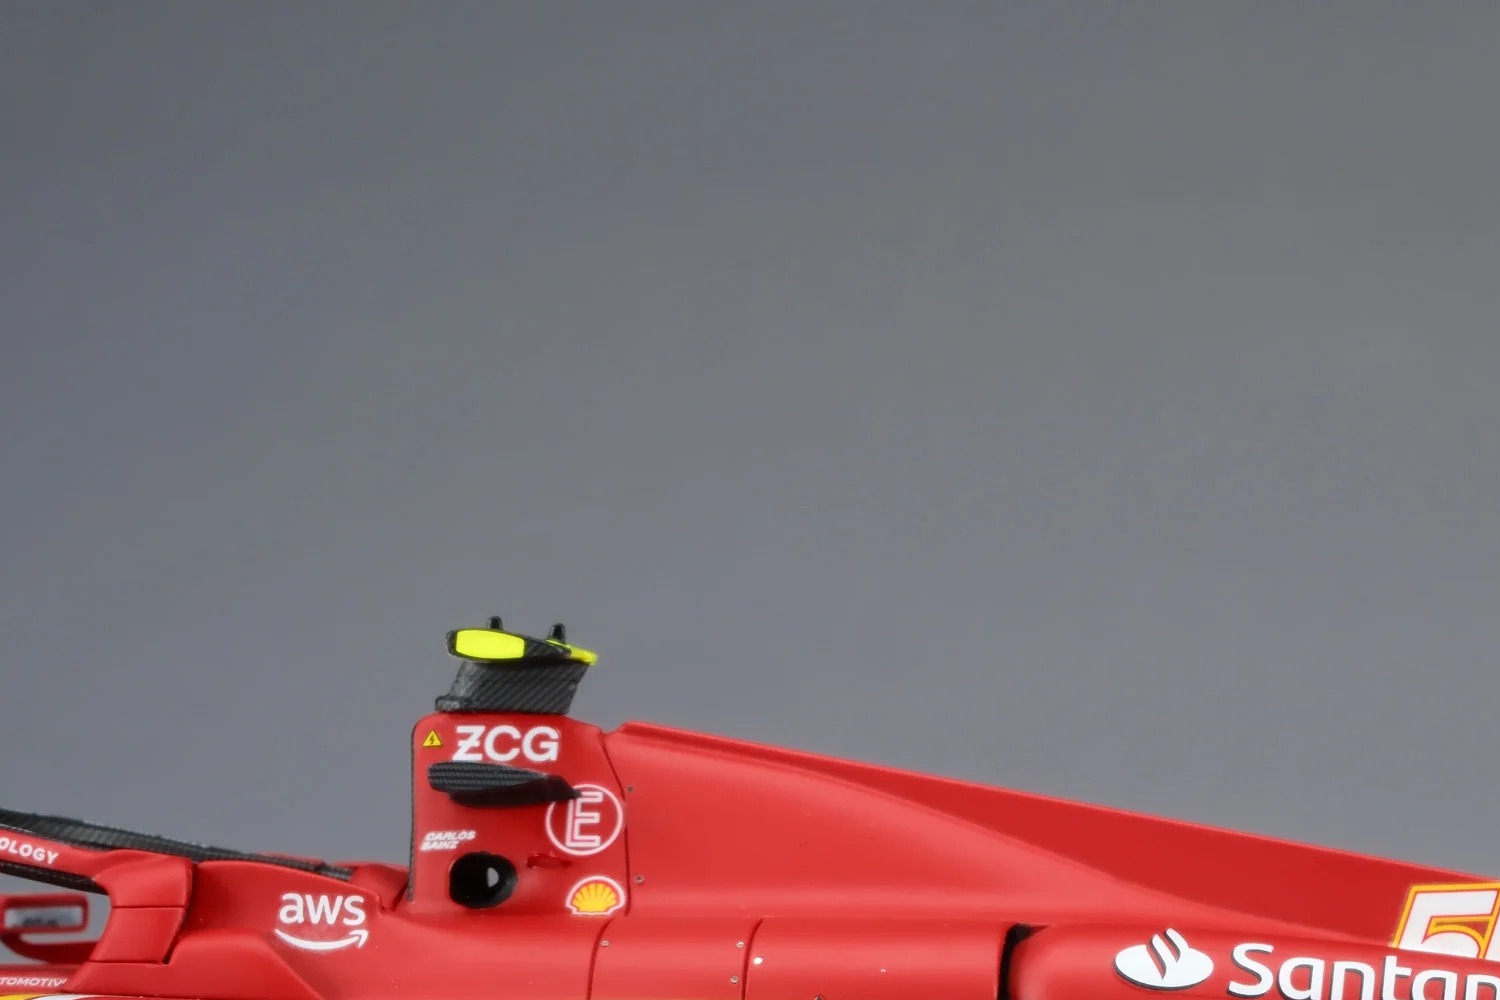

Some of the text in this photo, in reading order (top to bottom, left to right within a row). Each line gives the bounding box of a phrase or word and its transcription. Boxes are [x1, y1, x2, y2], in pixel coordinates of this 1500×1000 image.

[452, 725, 561, 762] ZCG
[279, 893, 366, 926] aws
[0, 977, 68, 987] TOMOTIV
